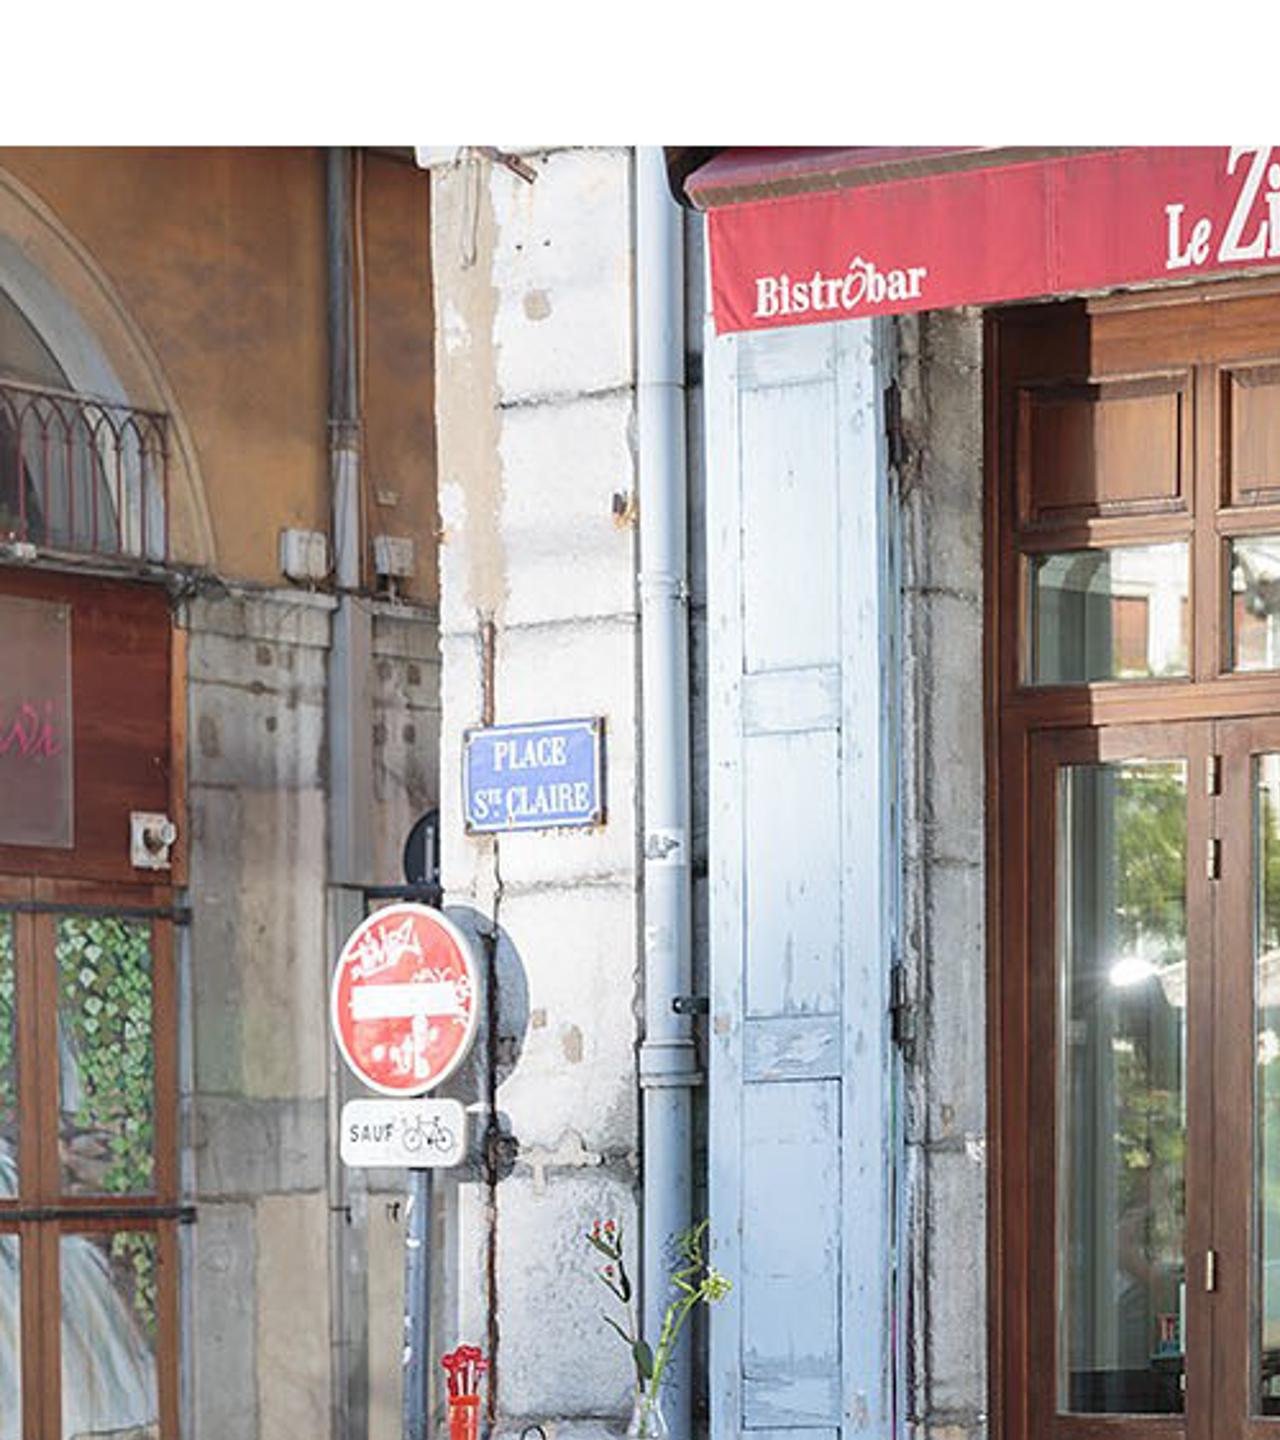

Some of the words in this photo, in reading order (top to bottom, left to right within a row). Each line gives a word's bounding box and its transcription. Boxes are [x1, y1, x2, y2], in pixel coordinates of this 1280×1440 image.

[1164, 203, 1213, 271] Le
[492, 735, 567, 772] PLACE
[506, 782, 590, 818] CLAIRE
[349, 1122, 395, 1144] SAUF
